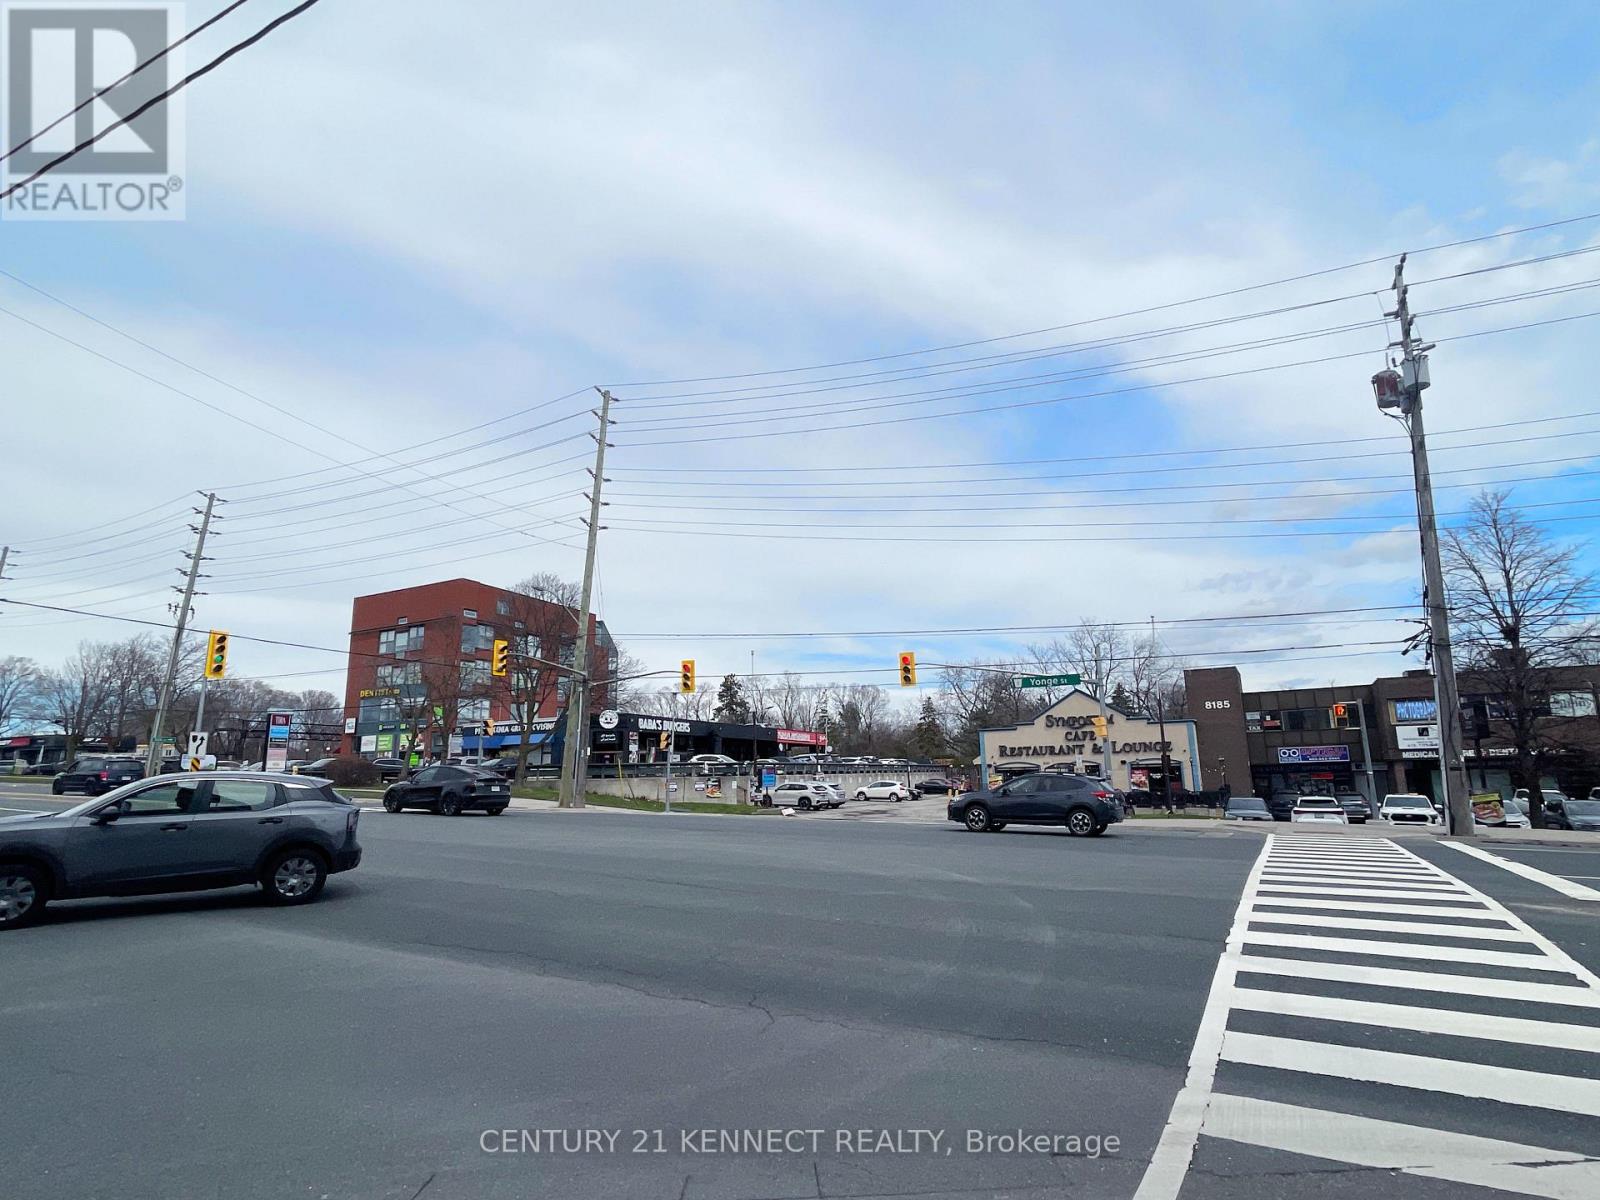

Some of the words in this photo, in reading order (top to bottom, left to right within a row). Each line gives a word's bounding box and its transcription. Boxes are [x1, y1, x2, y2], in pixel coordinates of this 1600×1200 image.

[1030, 678, 1058, 686] Yonge
[1204, 700, 1231, 709] 8185
[638, 717, 662, 730] BABA'S
[998, 743, 1085, 757] RESTAURANT
[1092, 743, 1104, 754] &
[1110, 740, 1173, 754] LOUNGE
[1402, 750, 1439, 759] MEDICAL
